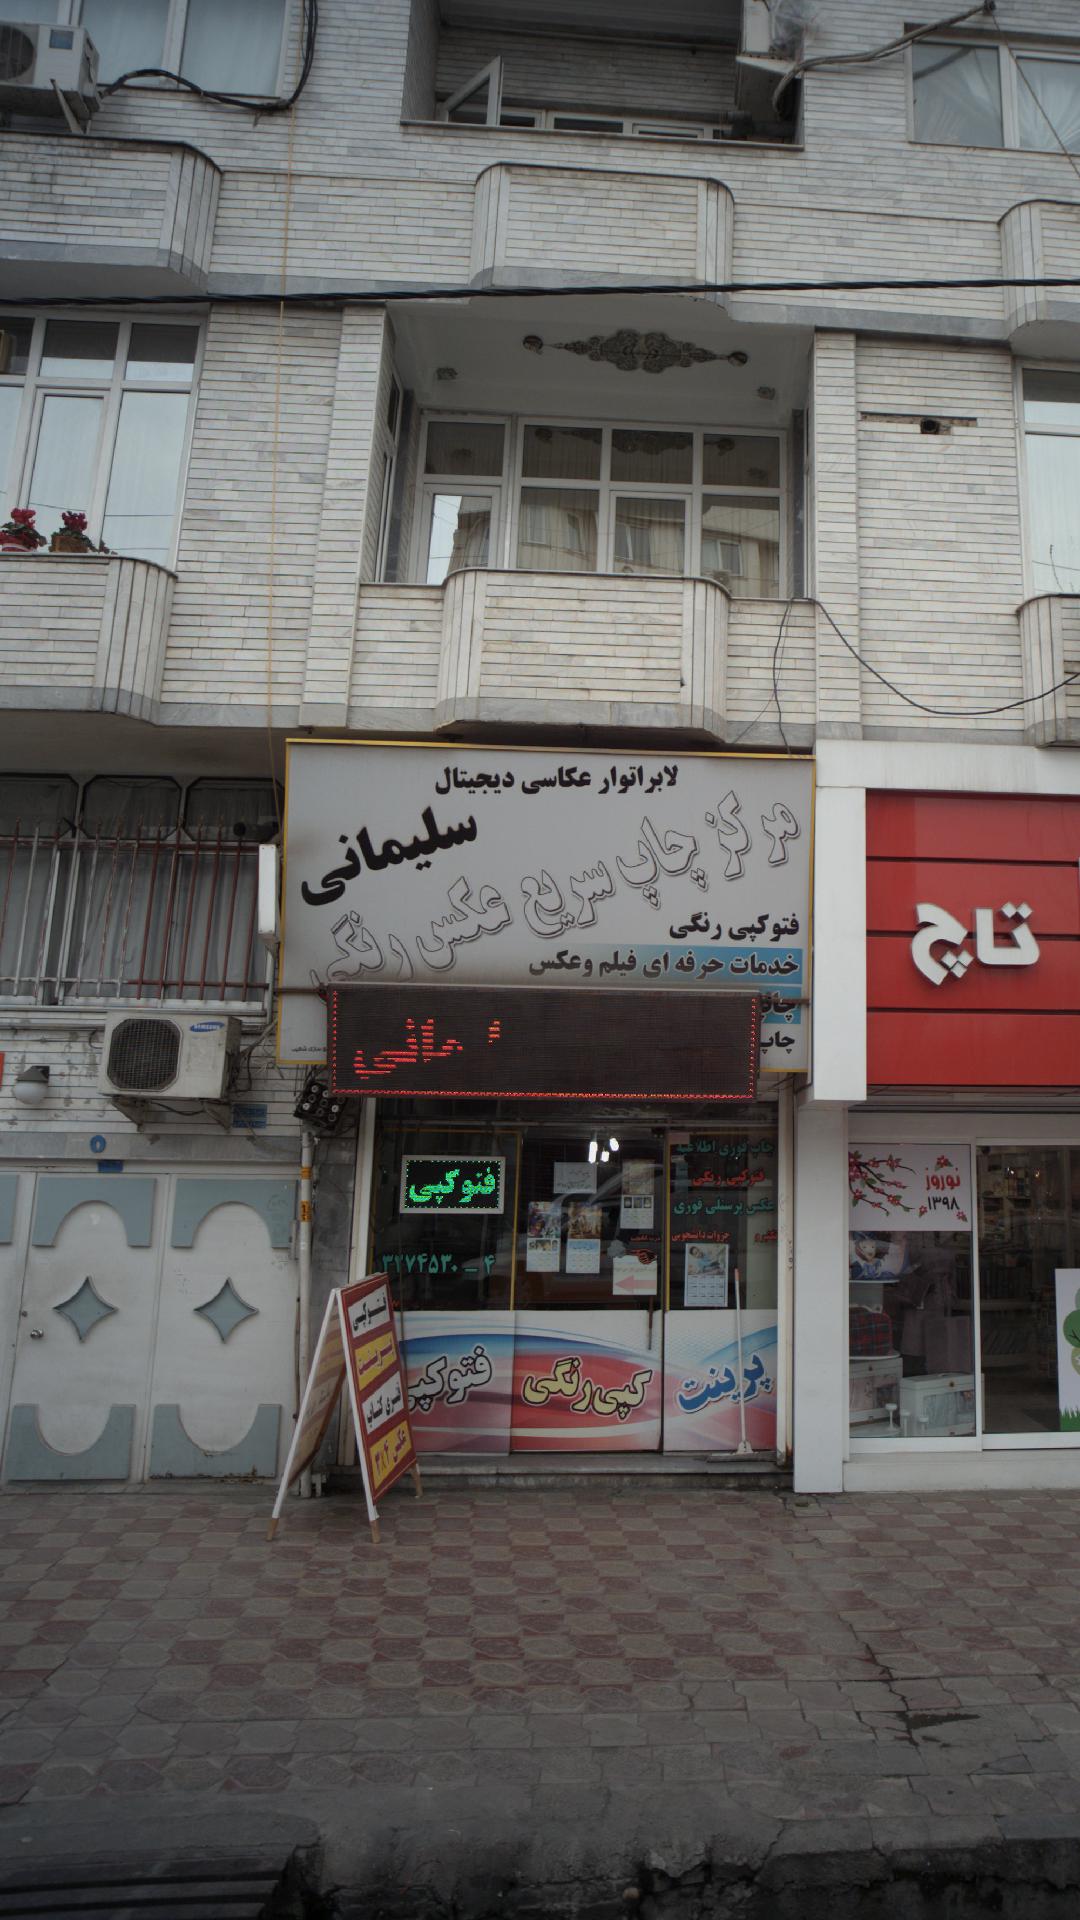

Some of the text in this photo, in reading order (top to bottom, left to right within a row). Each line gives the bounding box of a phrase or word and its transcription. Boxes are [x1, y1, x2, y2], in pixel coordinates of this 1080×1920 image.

[434, 764, 679, 795] لابراتوار عکاسی دیجیتال
[704, 790, 802, 881] مرکز
[301, 805, 478, 906] سلیمانی
[615, 816, 706, 910] چاپ
[521, 859, 616, 937] سریع
[416, 876, 512, 971] عکس
[669, 912, 800, 942] فتوکپی رنگی
[911, 902, 1040, 986] تاچ
[598, 949, 637, 977] فیلم
[643, 952, 669, 978] ای
[674, 952, 723, 979] حرفه
[729, 952, 799, 976] خدمات
[691, 1169, 723, 1187] رنگی
[925, 1167, 961, 1191] نوروز
[673, 1196, 704, 1216] فوری
[746, 1197, 776, 1216] عکس
[927, 1195, 960, 1211] ۱۳۹۸
[522, 1357, 653, 1420] کپی رنگی
[675, 1352, 772, 1415] پرینت
